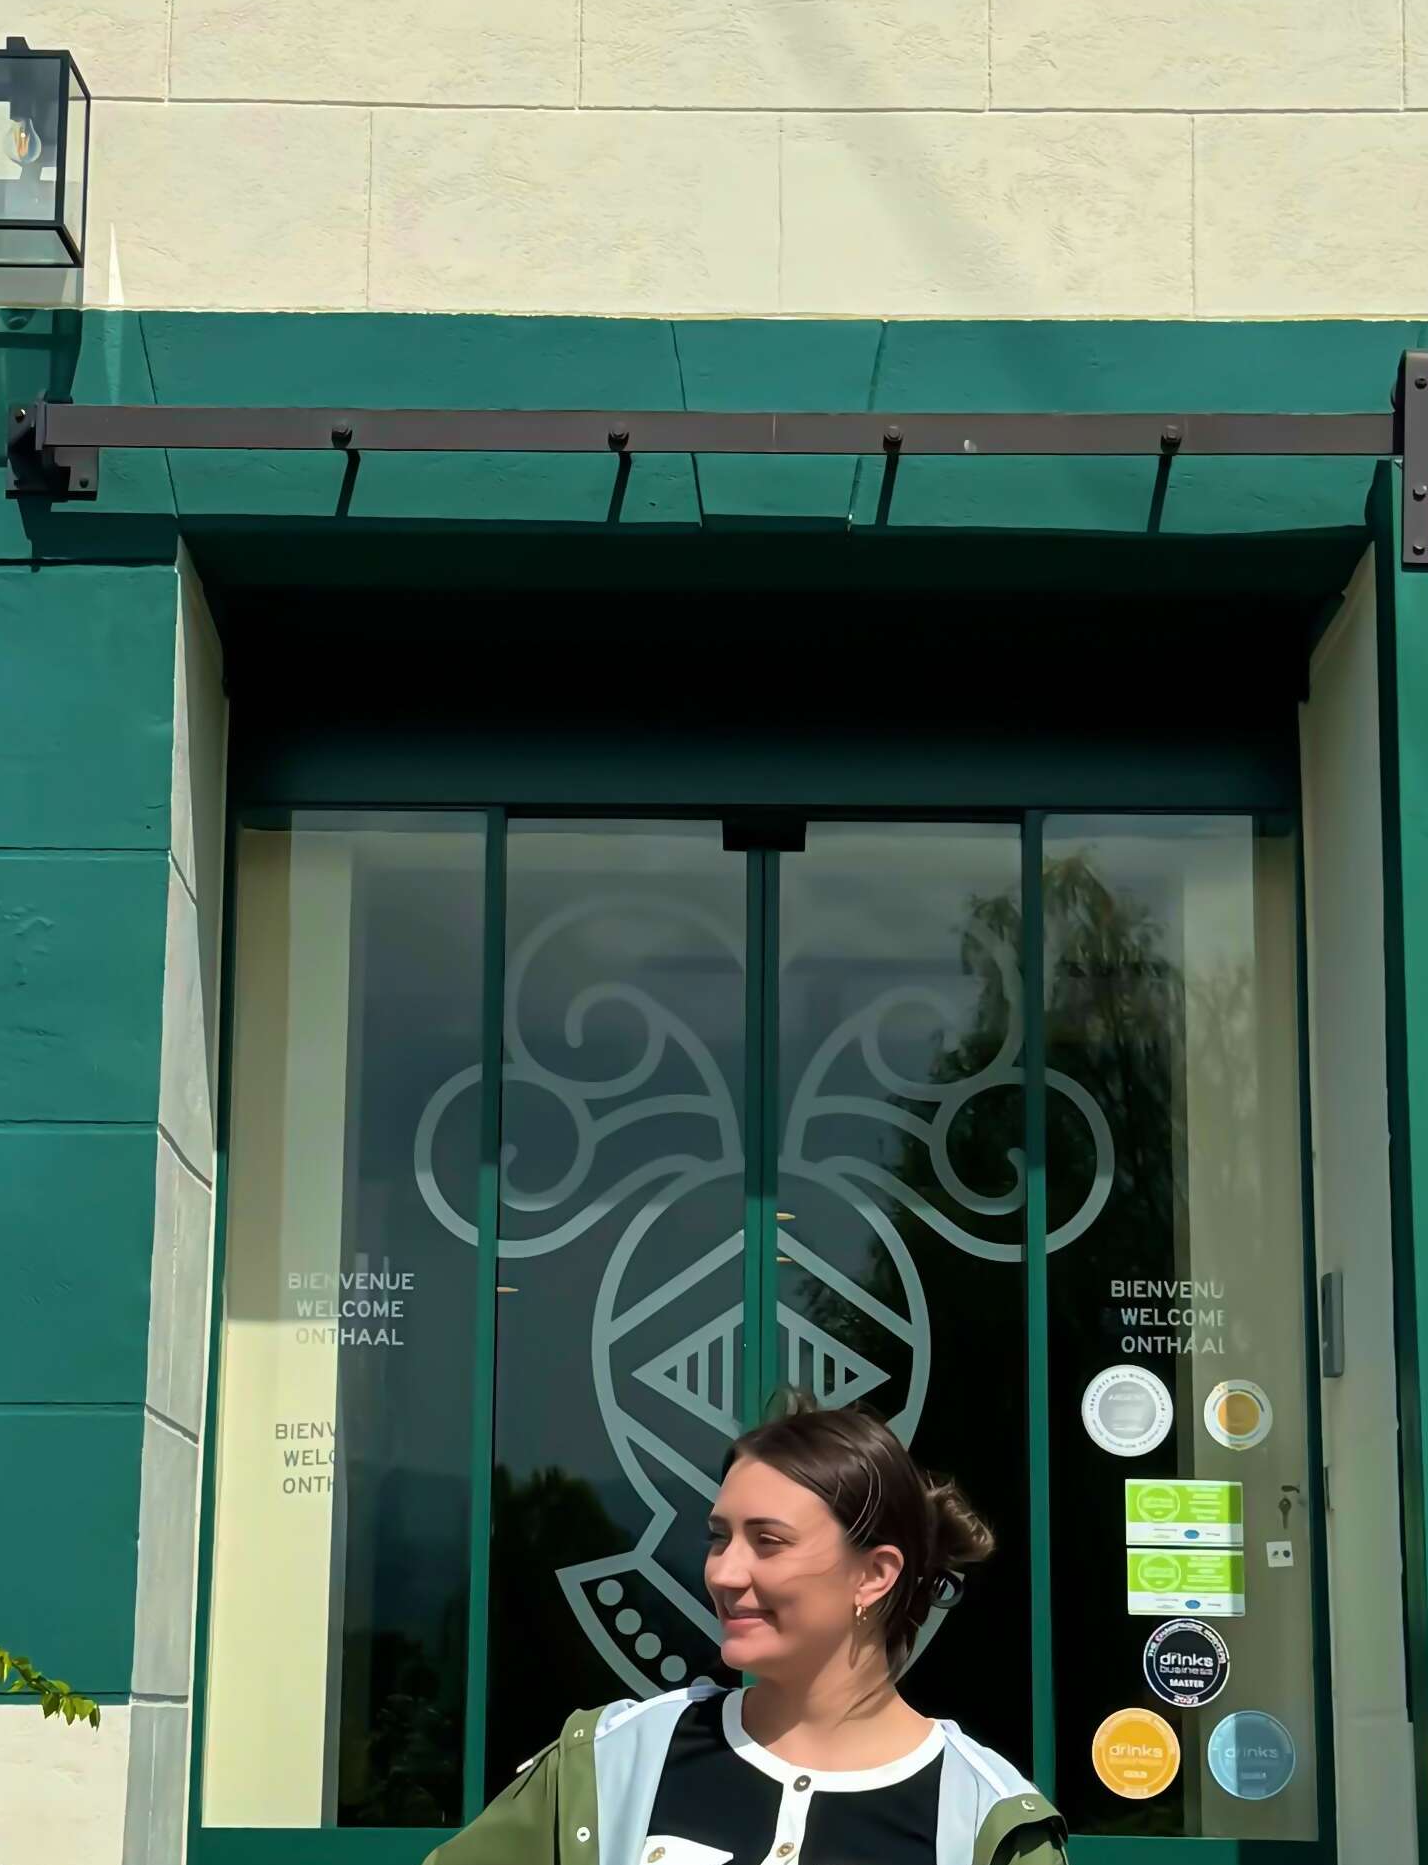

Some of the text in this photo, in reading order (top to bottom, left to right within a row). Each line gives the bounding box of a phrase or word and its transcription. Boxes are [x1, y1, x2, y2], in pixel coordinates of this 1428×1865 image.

[288, 1272, 415, 1290] BIENVENUE
[296, 1300, 404, 1318] WELCOME
[295, 1327, 405, 1346] ONTHAAL
[1159, 1652, 1214, 1667] drinks
[1109, 1743, 1163, 1758] drinks
[1224, 1745, 1277, 1758] dinks
